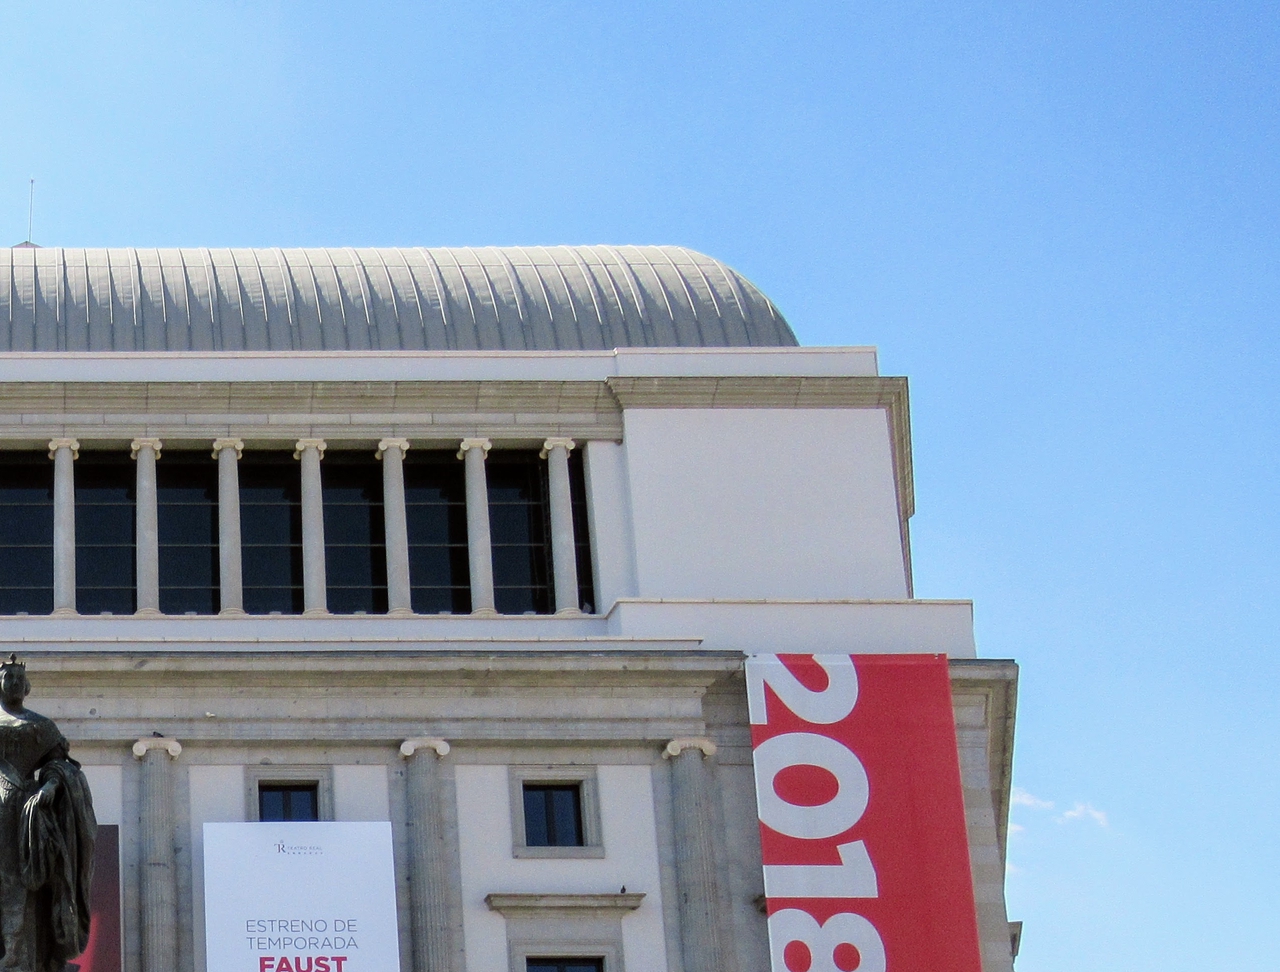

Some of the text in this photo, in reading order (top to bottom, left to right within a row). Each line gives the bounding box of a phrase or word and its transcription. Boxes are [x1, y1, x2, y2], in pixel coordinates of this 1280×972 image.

[246, 919, 358, 933] ESTRENO DE
[246, 936, 359, 950] TEMPORADA
